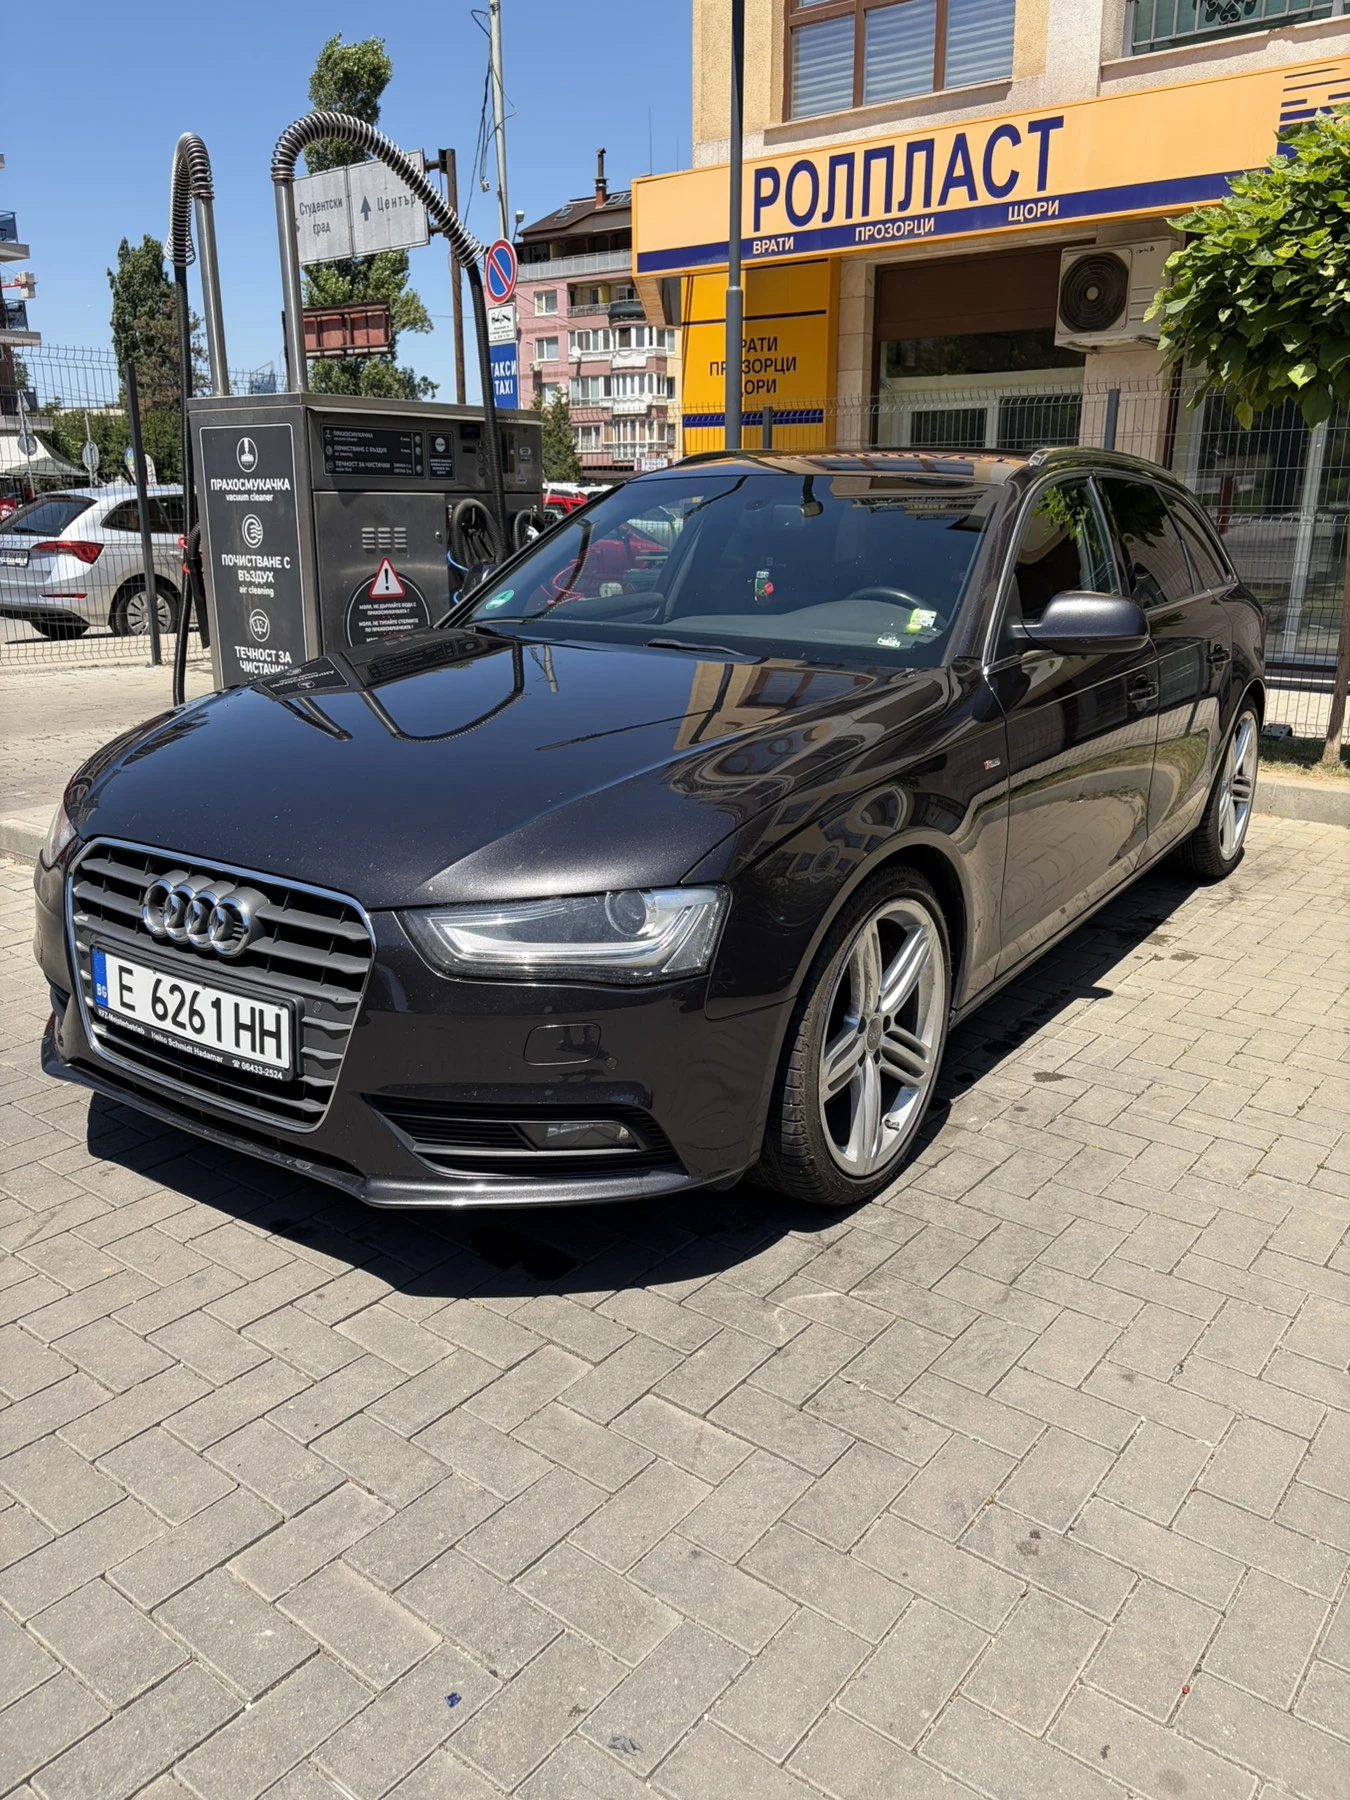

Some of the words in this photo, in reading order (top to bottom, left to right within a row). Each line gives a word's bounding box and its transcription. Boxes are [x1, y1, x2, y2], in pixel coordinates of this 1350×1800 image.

[752, 115, 1065, 233] РОЛПЛАСТ
[299, 197, 343, 216] Студентски
[377, 193, 416, 212] Център
[313, 221, 331, 237] град
[752, 236, 795, 255] ВРАТИ
[855, 217, 935, 242] ПРОЗОРЦИ
[1007, 199, 1060, 222] ЩОРИ
[709, 356, 797, 376] ПРЗОРЦИ
[494, 379, 513, 395] TAXI
[742, 378, 777, 396] ОРИ
[210, 478, 291, 491] ПРАХОСМУКАЧКА
[250, 492, 273, 501] cleaner
[221, 554, 282, 568] ПОЧИСТВАНЕ
[283, 556, 291, 568] С
[237, 570, 274, 584] ВЪЗДУХ
[239, 585, 248, 594] air
[248, 585, 274, 598] cleaning
[234, 645, 277, 662] ТЕЧНОСТ
[278, 651, 292, 664] ЗА
[96, 983, 107, 998] BG
[118, 964, 136, 1013] E
[151, 977, 222, 1043] 6261
[168, 1037, 193, 1054] Schmidt
[194, 1047, 223, 1063] Hadamar
